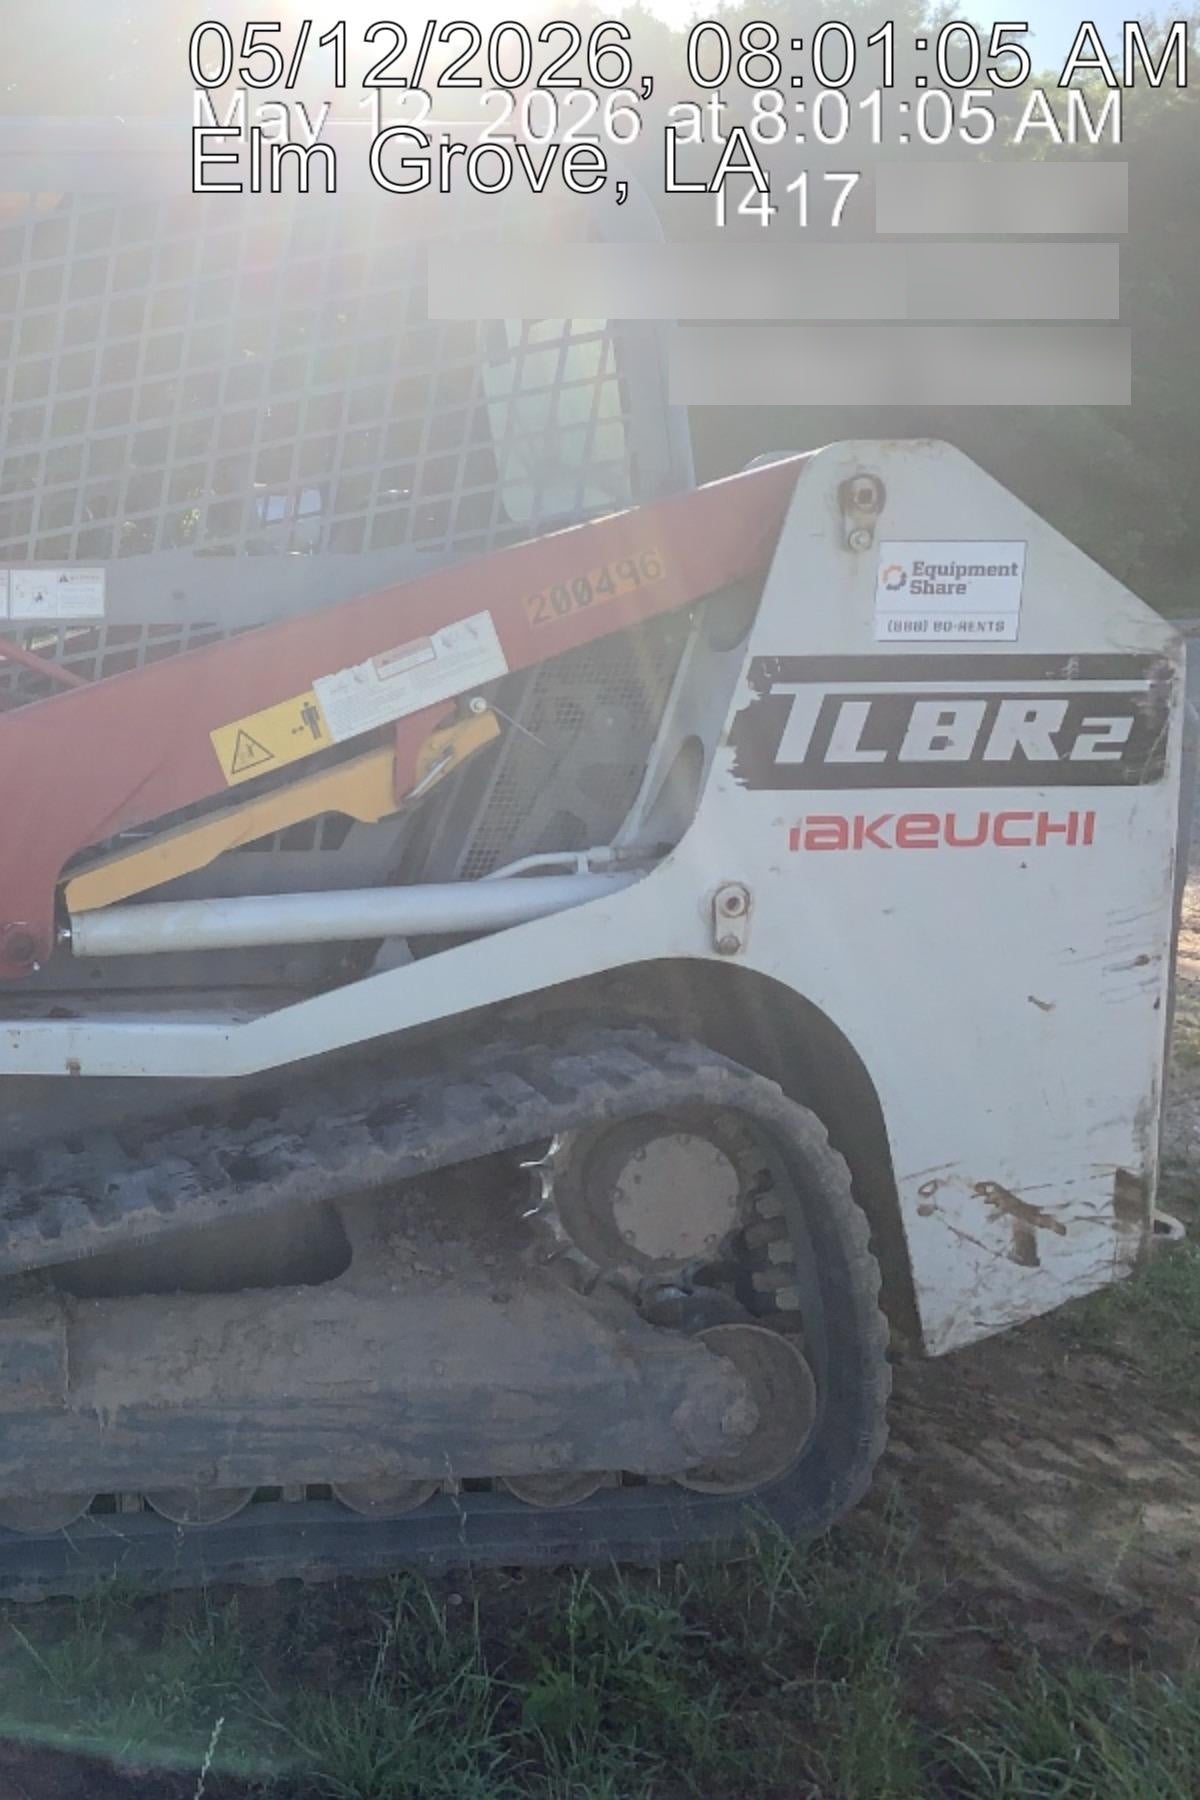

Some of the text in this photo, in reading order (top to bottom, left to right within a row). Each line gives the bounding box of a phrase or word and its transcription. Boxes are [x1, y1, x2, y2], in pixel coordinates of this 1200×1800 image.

[910, 560, 1020, 581] Equipment
[526, 549, 663, 626] 200496
[909, 579, 968, 595] Share
